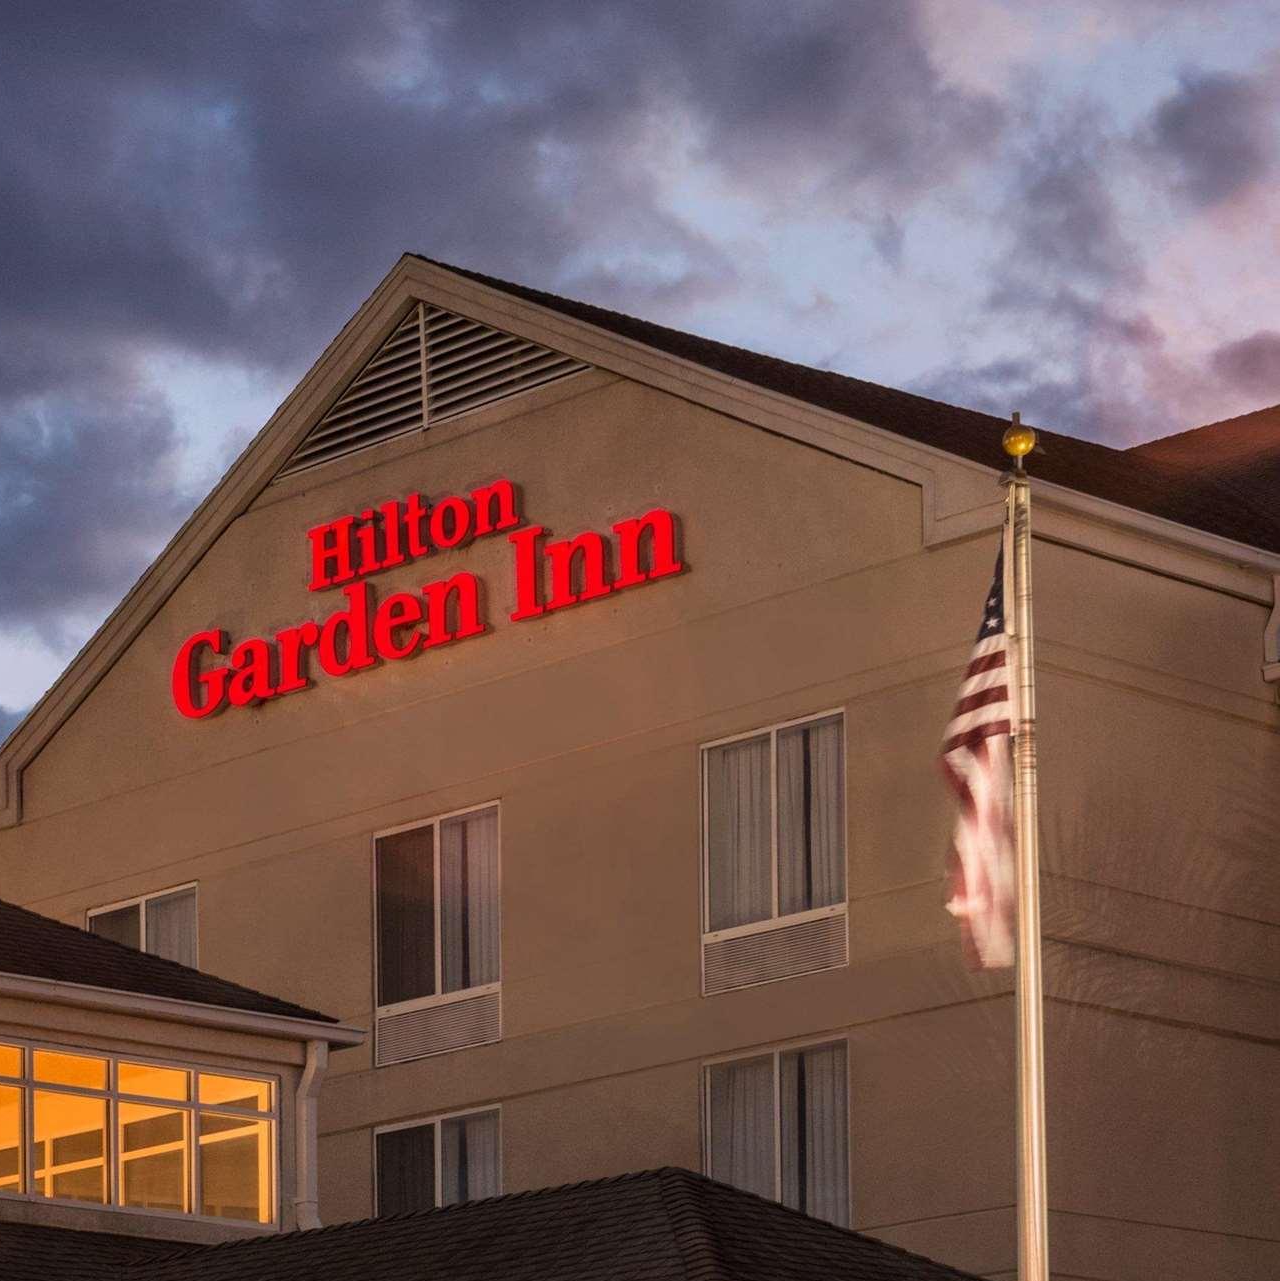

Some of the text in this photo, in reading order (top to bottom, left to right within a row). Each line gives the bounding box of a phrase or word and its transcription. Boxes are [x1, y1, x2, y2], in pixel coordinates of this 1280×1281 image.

[170, 507, 683, 720] Garden Inn
[305, 478, 520, 593] Hilton
